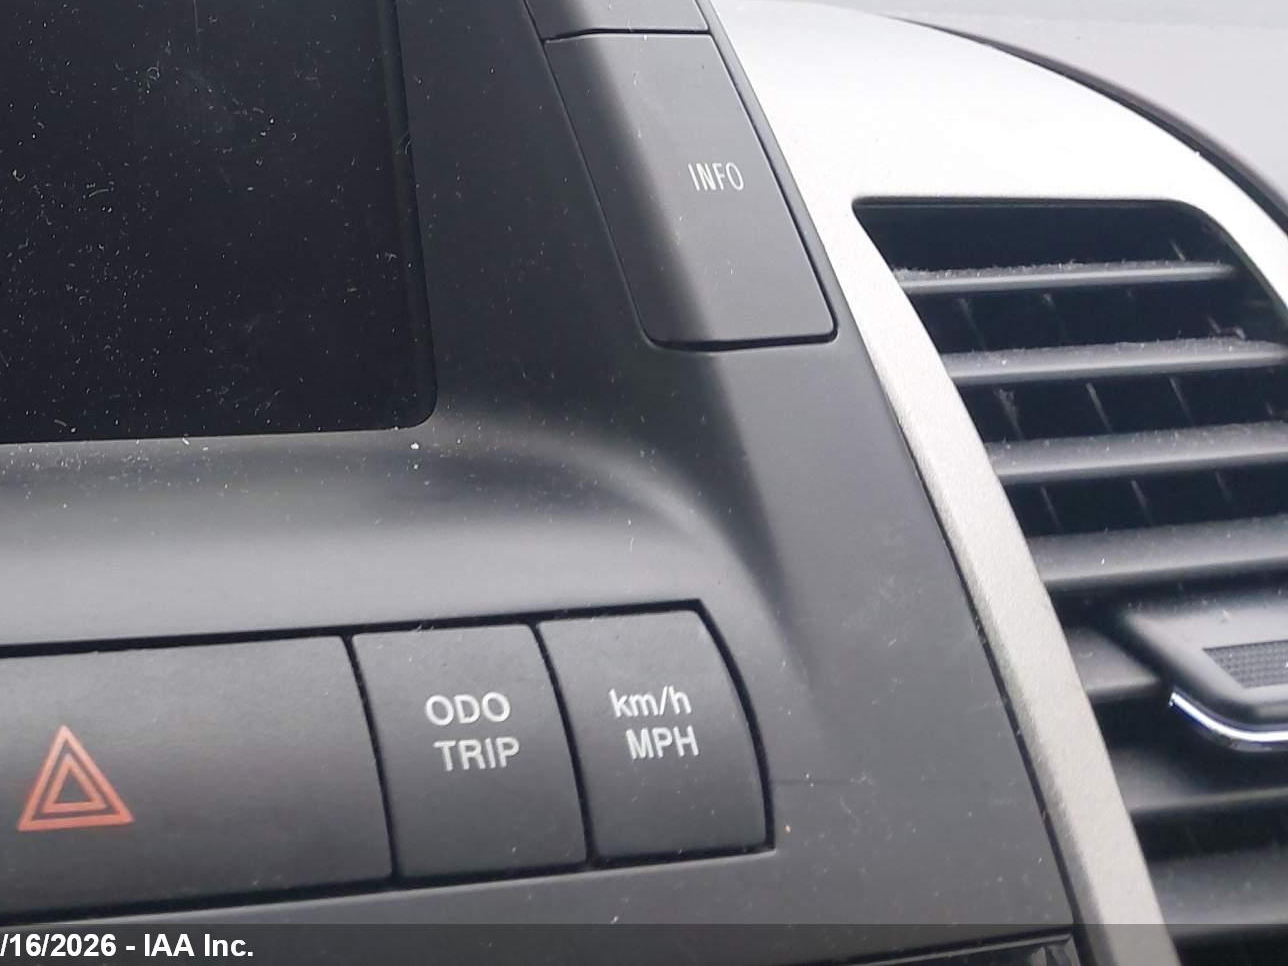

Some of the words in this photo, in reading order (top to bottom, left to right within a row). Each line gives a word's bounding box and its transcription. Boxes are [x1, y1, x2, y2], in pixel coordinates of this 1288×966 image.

[687, 161, 744, 191] INFO
[425, 691, 511, 726] ODO
[608, 685, 692, 718] km/h
[433, 736, 520, 771] TRIP
[625, 724, 699, 760] MPH
